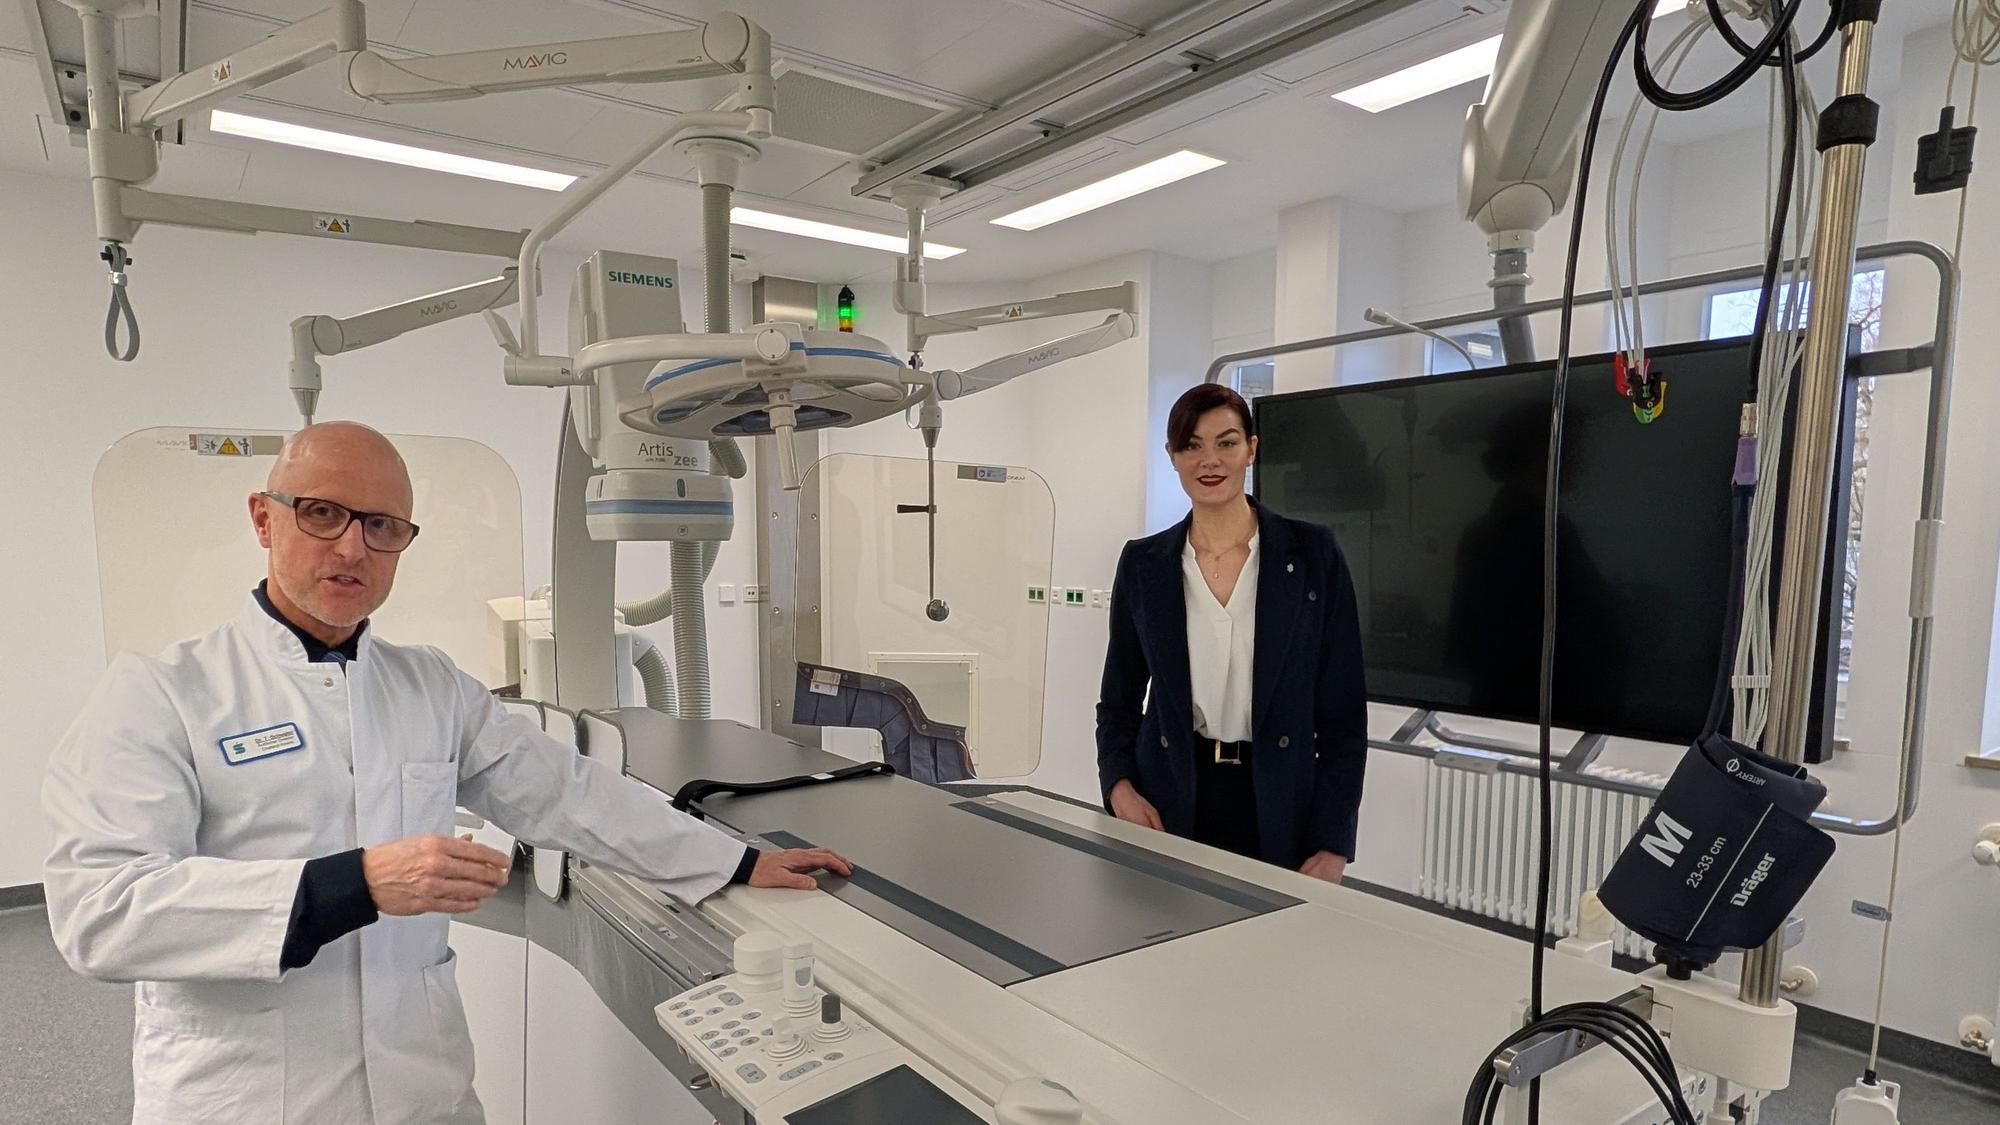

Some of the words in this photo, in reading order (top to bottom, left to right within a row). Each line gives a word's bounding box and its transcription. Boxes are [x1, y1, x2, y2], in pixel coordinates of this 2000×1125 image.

[503, 52, 567, 70] MAVIG
[608, 271, 673, 288] SIEMENS
[638, 442, 674, 457] Artis
[673, 455, 699, 467] zee
[1736, 771, 1767, 787] ARTERY
[1640, 811, 1693, 868] M
[1686, 855, 1714, 888] 23-33
[1710, 836, 1727, 855] cm
[1730, 852, 1776, 907] Dräger
